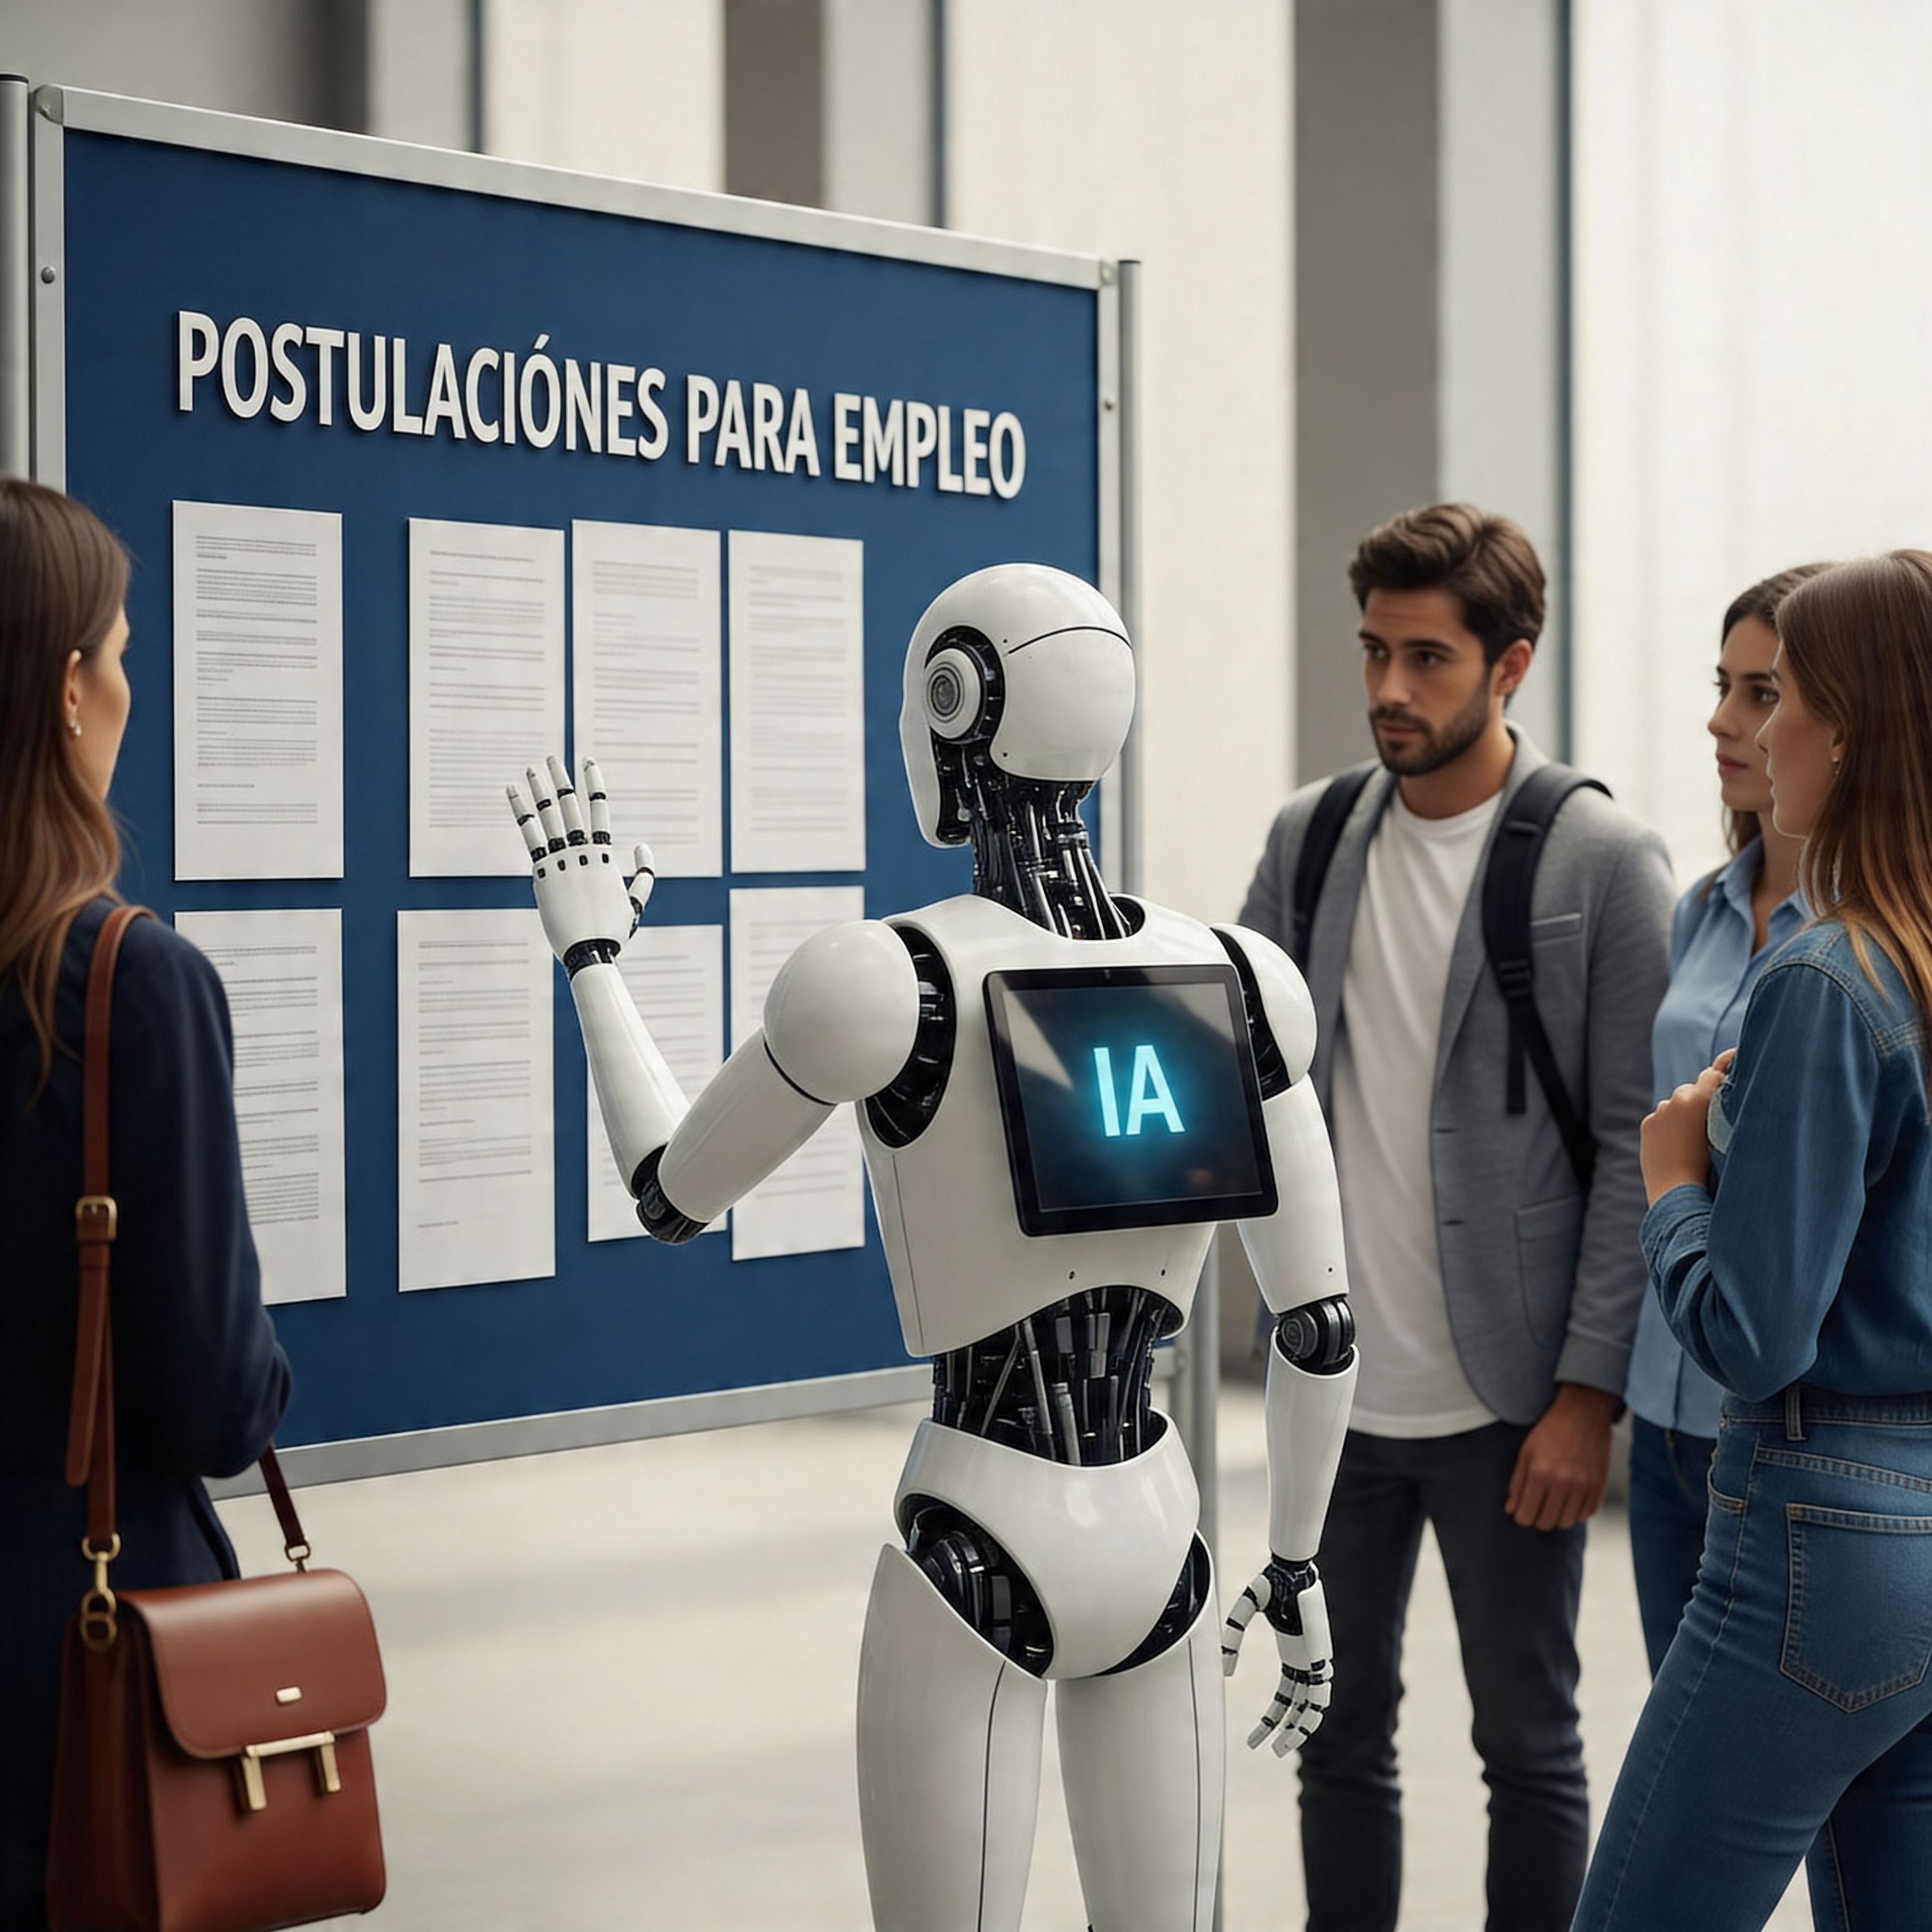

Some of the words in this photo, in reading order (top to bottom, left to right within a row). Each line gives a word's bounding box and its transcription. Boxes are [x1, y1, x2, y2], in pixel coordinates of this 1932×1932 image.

[178, 310, 668, 460] POSTULACIÓNES
[687, 374, 820, 477] PARA
[835, 393, 1027, 499] EMPLEO
[1094, 1045, 1186, 1137] IA
